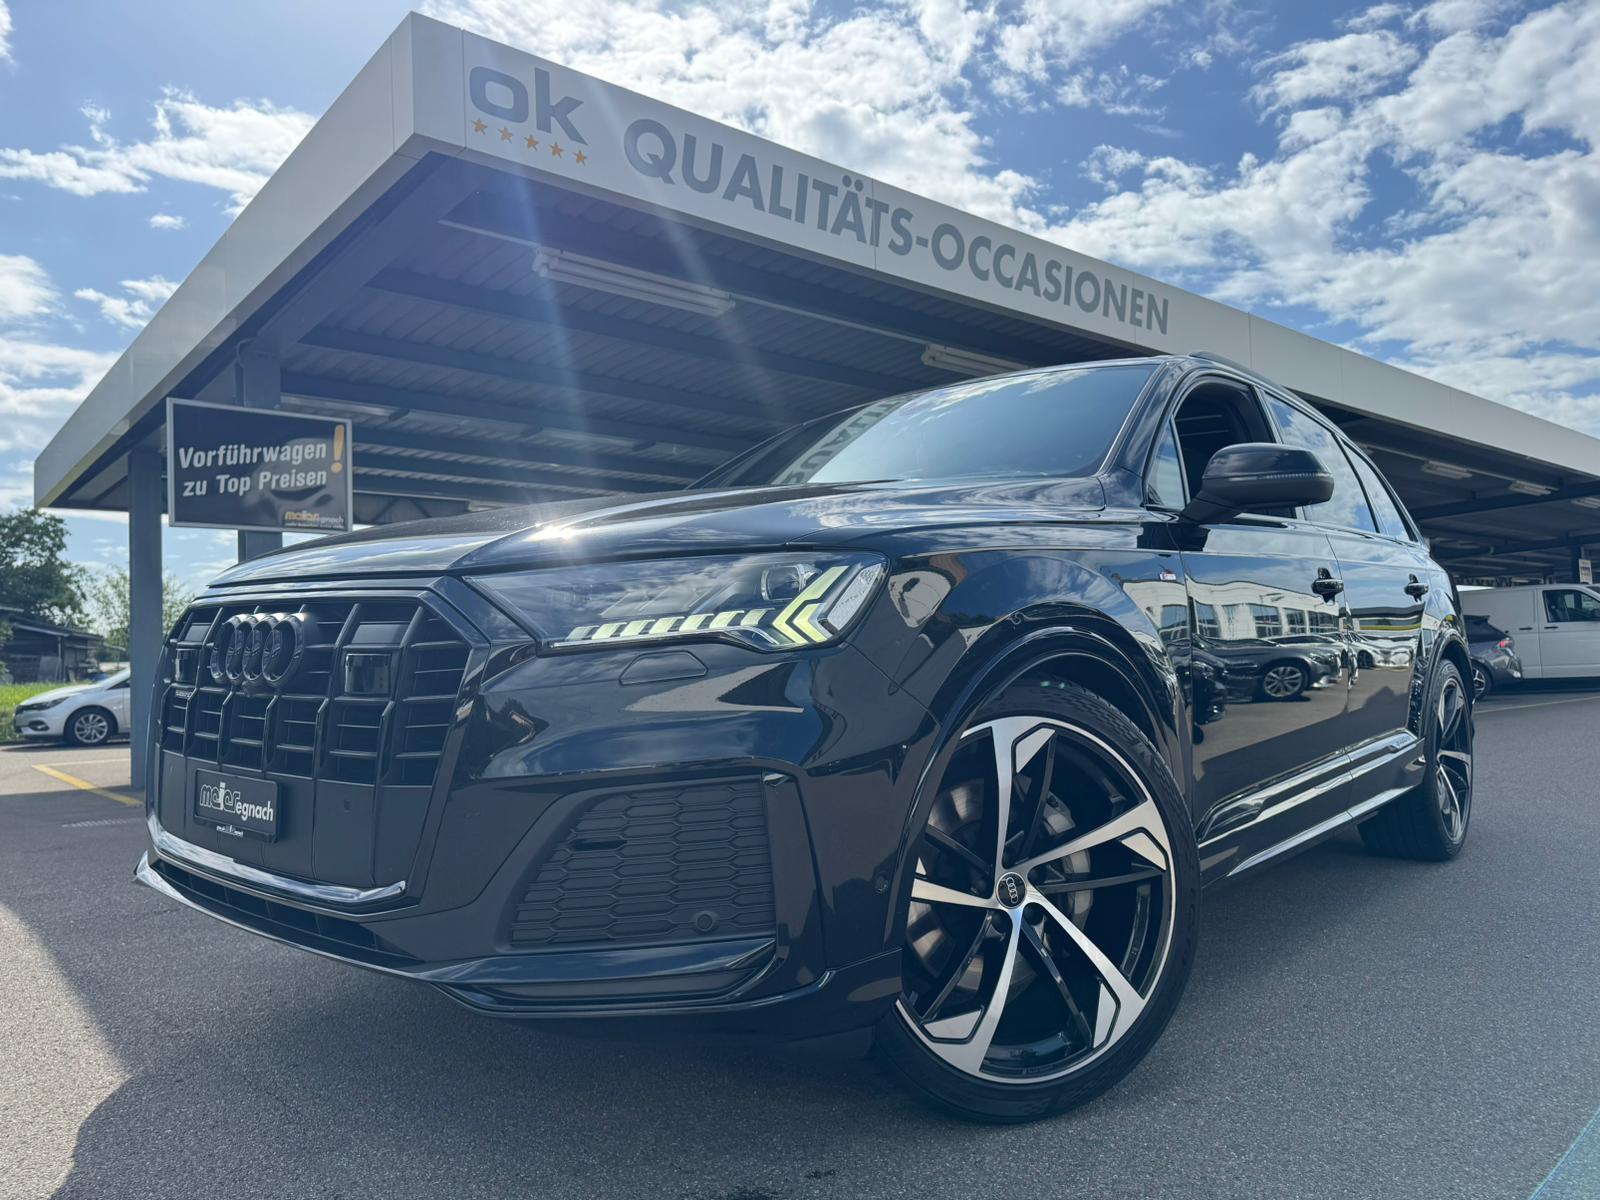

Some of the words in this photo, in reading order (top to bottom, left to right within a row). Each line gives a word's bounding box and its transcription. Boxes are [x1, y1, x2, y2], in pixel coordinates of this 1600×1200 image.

[469, 65, 588, 146] ok
[623, 118, 1169, 335] QUALITÄTS-OCCASIONEN
[178, 442, 327, 469] Vorführwagen
[182, 479, 207, 497] zu
[216, 474, 251, 496] Top
[258, 469, 327, 490] Preisen
[236, 800, 274, 821] egnach
